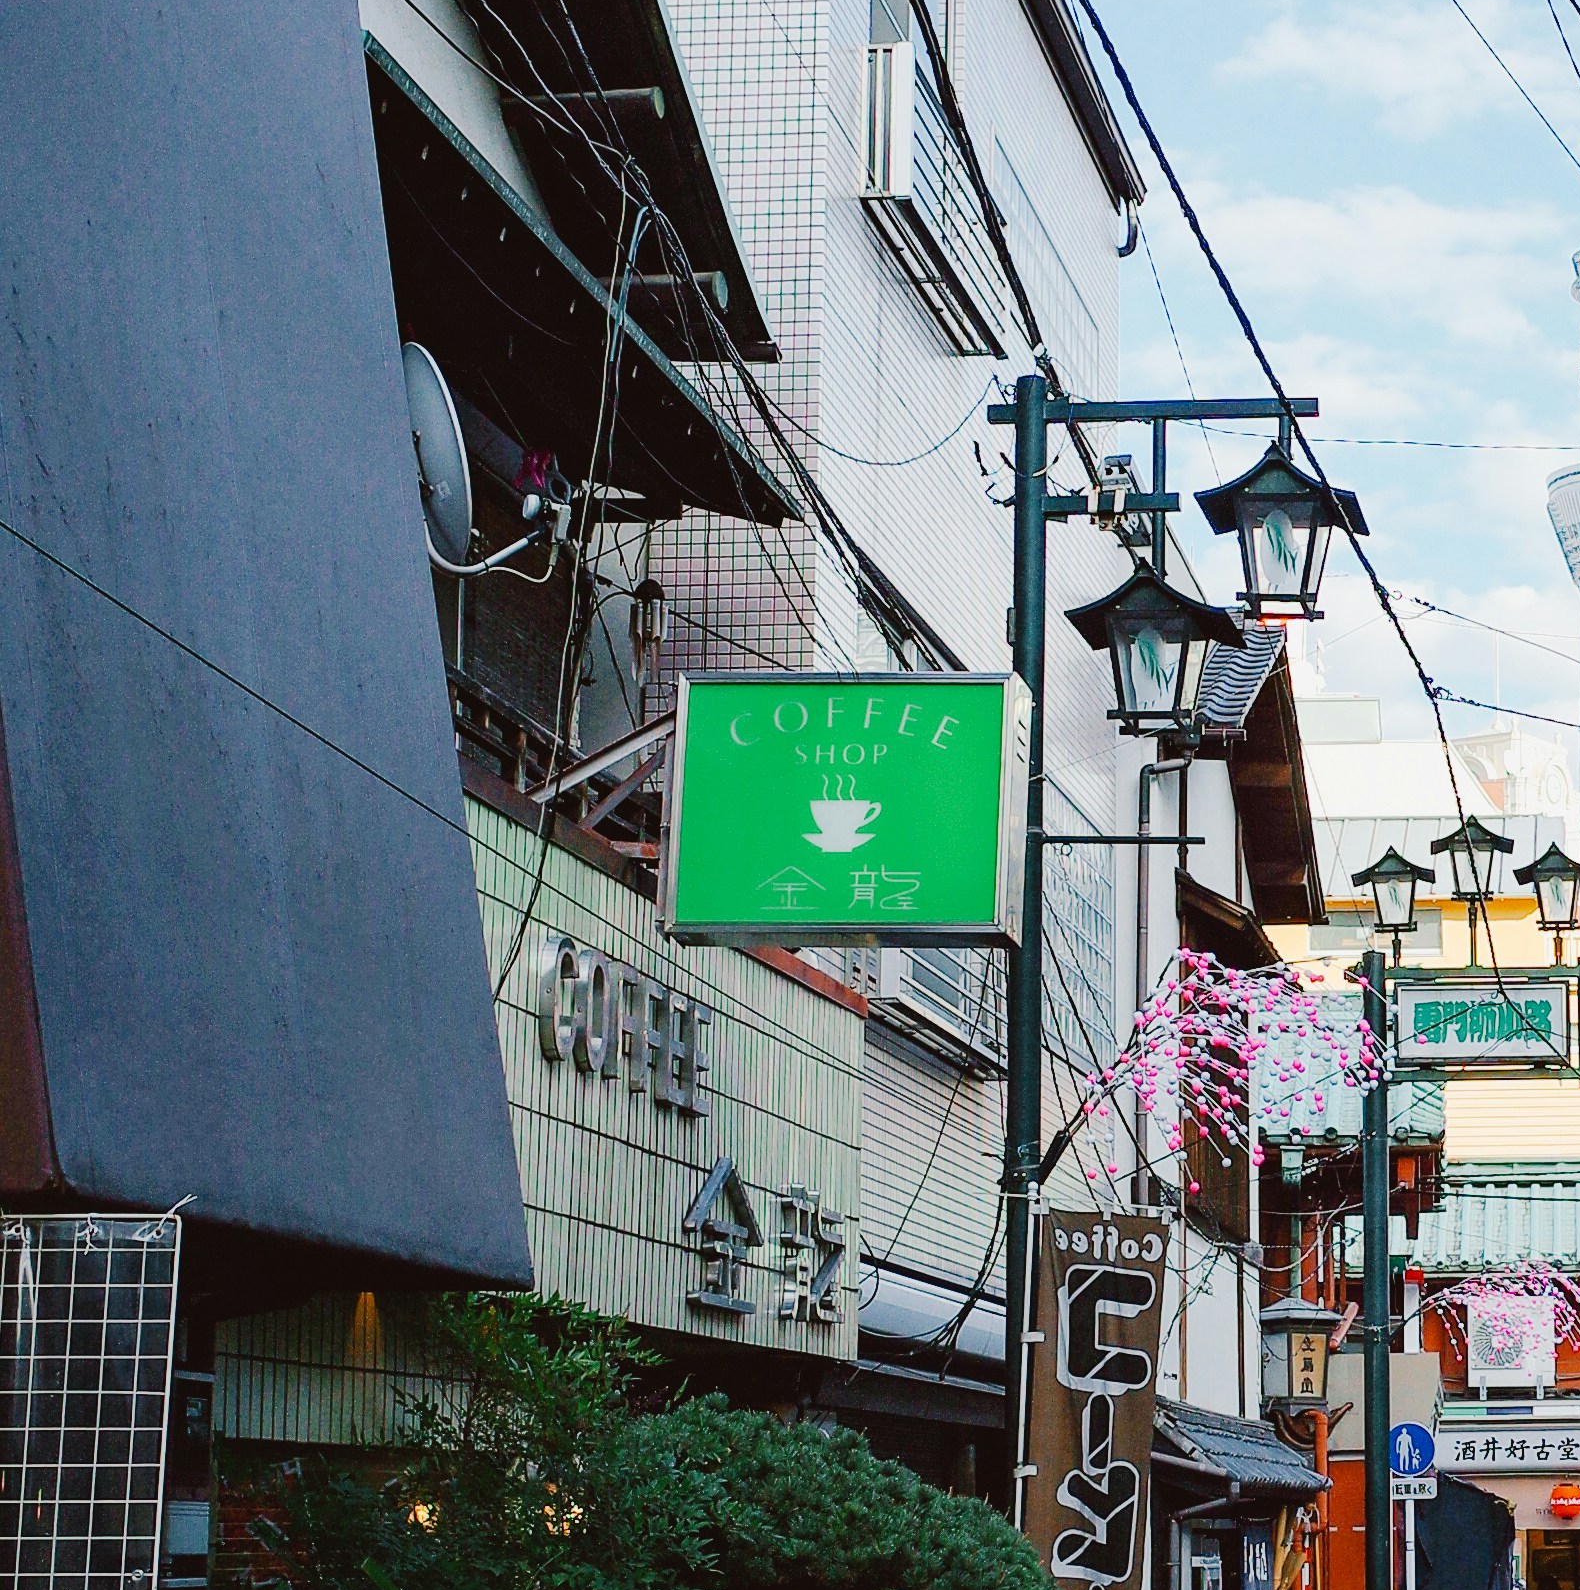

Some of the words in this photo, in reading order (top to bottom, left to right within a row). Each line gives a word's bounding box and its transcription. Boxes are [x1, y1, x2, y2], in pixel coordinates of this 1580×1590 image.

[730, 697, 959, 751] COFFEE
[794, 744, 888, 766] SHOP
[756, 865, 921, 910] 金龍
[540, 936, 711, 1117] COFFEE
[1454, 1438, 1580, 1461] 酒井好古堂
